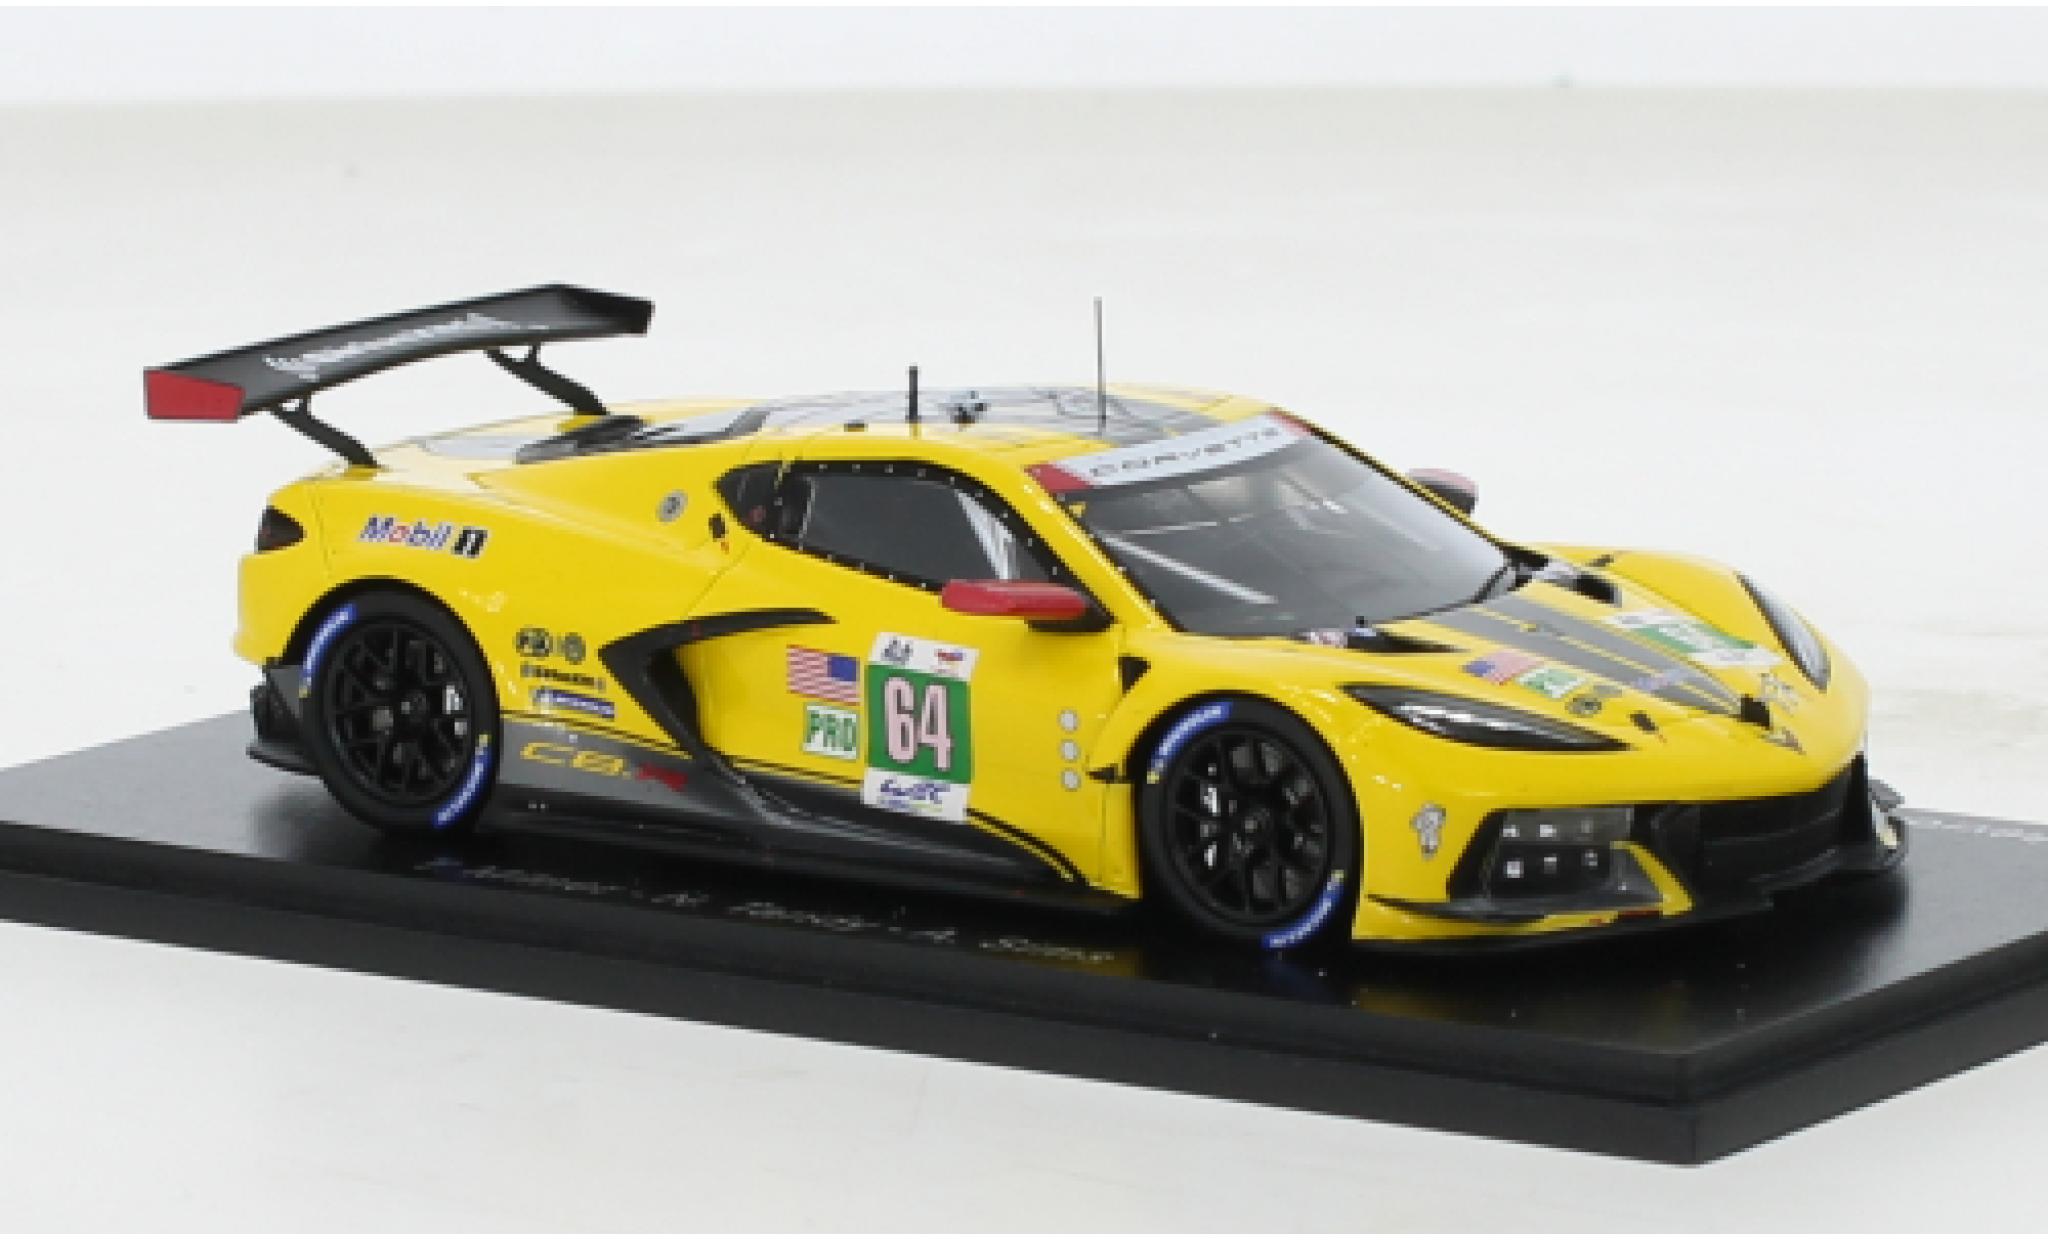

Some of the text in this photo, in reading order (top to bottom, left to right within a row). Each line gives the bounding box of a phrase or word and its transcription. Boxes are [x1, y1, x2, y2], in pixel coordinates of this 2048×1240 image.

[358, 515, 487, 558] Mobil 1
[806, 711, 857, 753] PRO
[884, 676, 954, 772] 64
